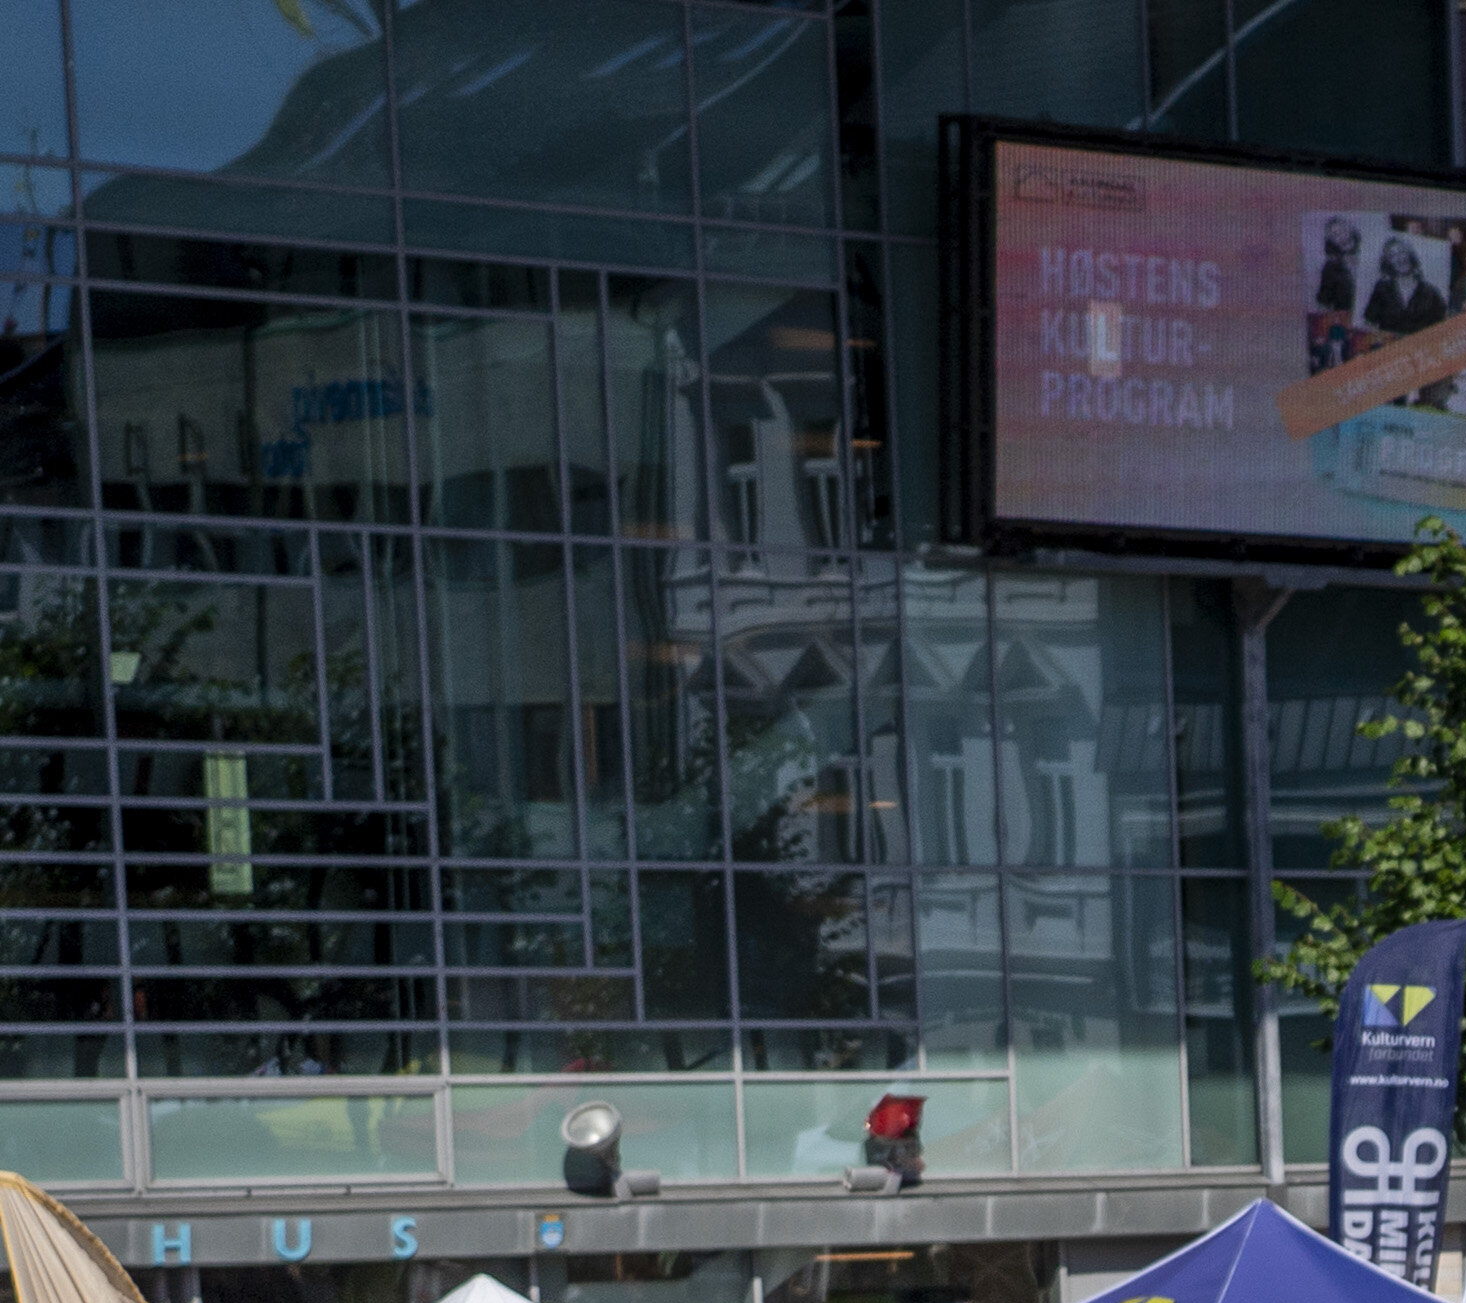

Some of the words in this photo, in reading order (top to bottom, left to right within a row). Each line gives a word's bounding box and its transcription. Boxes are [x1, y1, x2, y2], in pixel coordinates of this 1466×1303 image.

[1041, 249, 1222, 309] HØSTENS
[1041, 308, 1211, 367] KULTUR-
[1041, 369, 1234, 430] PROGRAM
[1361, 1030, 1435, 1048] Kulturvern
[1350, 1073, 1450, 1088] www.kulturvern.no
